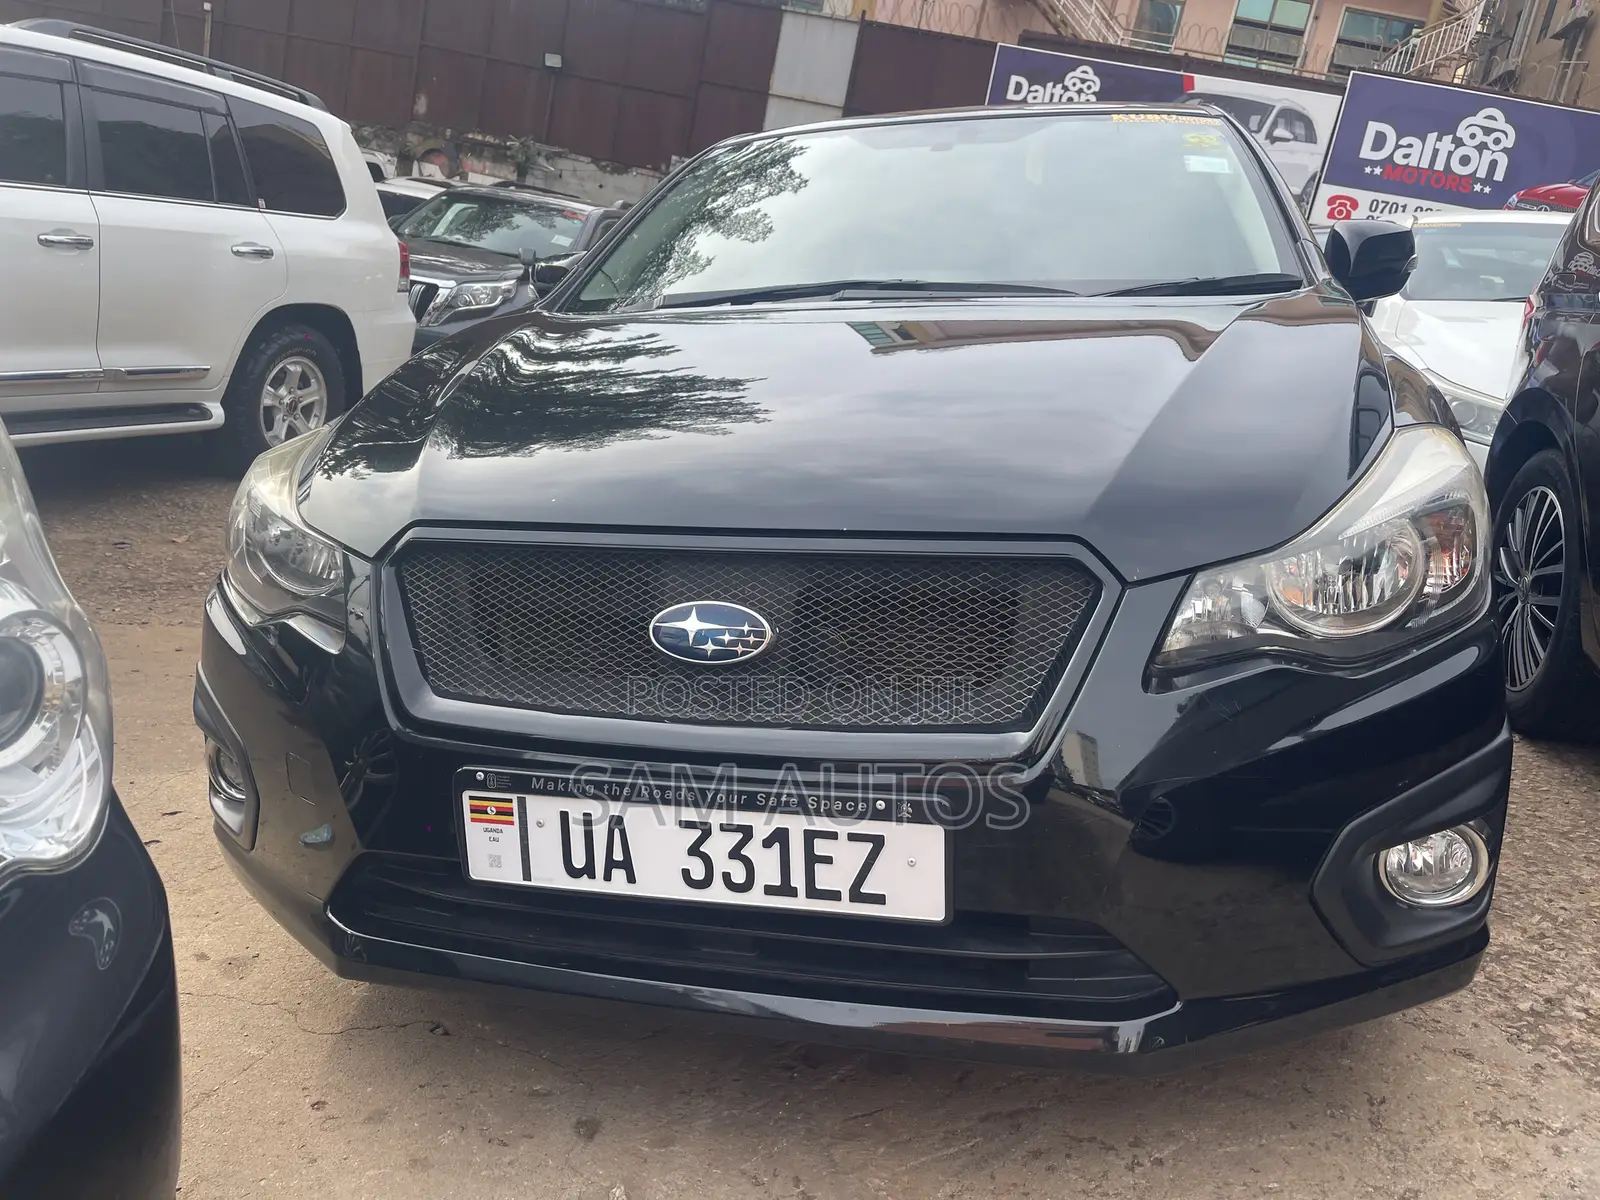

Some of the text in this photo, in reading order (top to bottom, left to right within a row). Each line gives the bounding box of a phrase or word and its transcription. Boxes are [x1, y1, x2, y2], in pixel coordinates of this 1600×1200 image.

[1359, 121, 1508, 182] Dalton
[1382, 164, 1474, 194] MOTORS
[1369, 198, 1408, 215] 0701
[531, 777, 595, 795] Making
[603, 781, 632, 796] the
[641, 785, 696, 801] Roads
[705, 789, 748, 805] Your
[756, 793, 798, 809] Safe
[808, 795, 868, 813] Space
[560, 810, 887, 906] UA 331EZ
